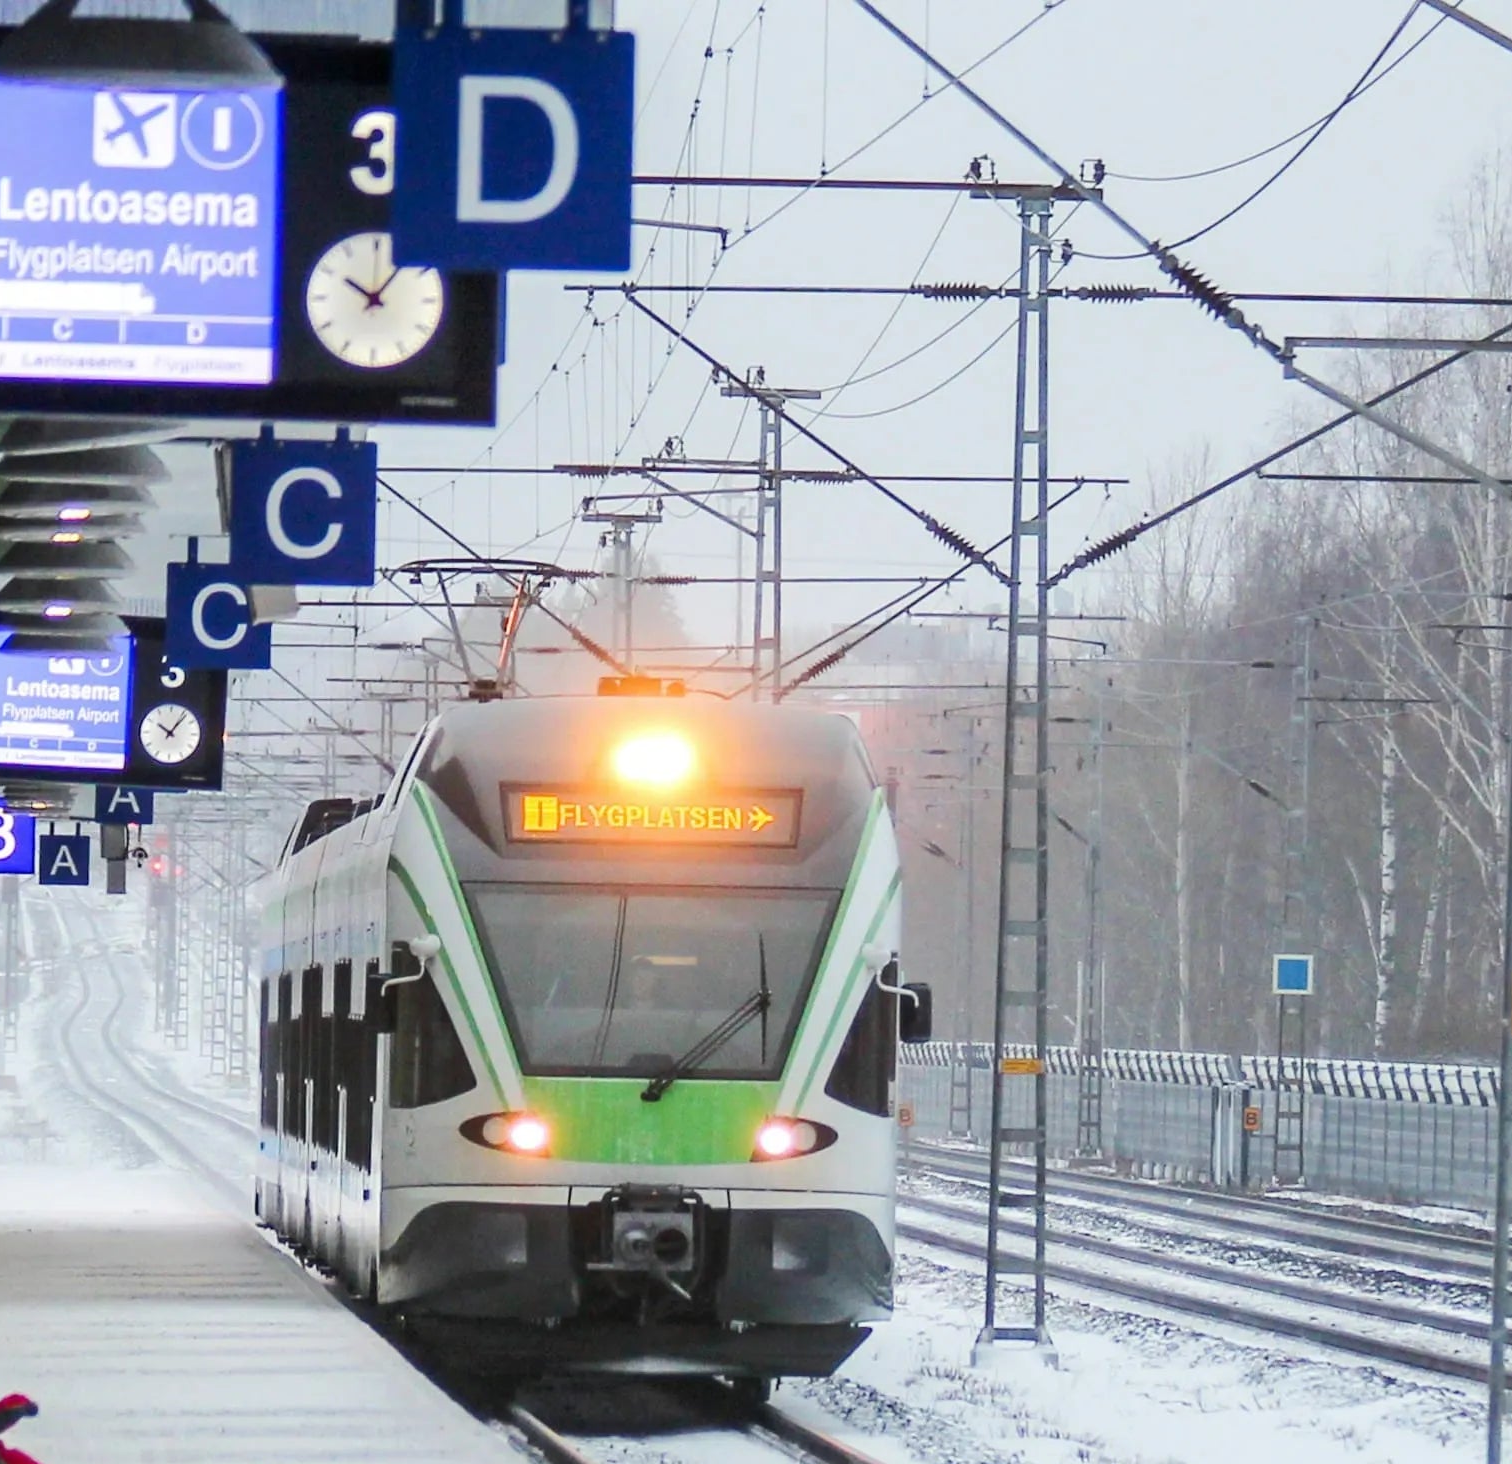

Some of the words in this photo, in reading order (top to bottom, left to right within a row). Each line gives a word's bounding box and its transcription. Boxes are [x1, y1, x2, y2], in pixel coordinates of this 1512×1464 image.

[350, 111, 395, 195] 3
[456, 75, 579, 222] D
[160, 242, 259, 283] Airport
[52, 316, 74, 341] C
[186, 321, 207, 345] D
[266, 467, 343, 559] C
[192, 583, 247, 649] C
[6, 676, 120, 701] Lentoasema
[2, 703, 74, 721] Flygplatsen
[77, 705, 120, 723] Airport
[108, 786, 140, 813] A
[559, 804, 742, 830] FLYGPLATSEN
[50, 845, 78, 876] A
[1245, 1111, 1258, 1125] B
